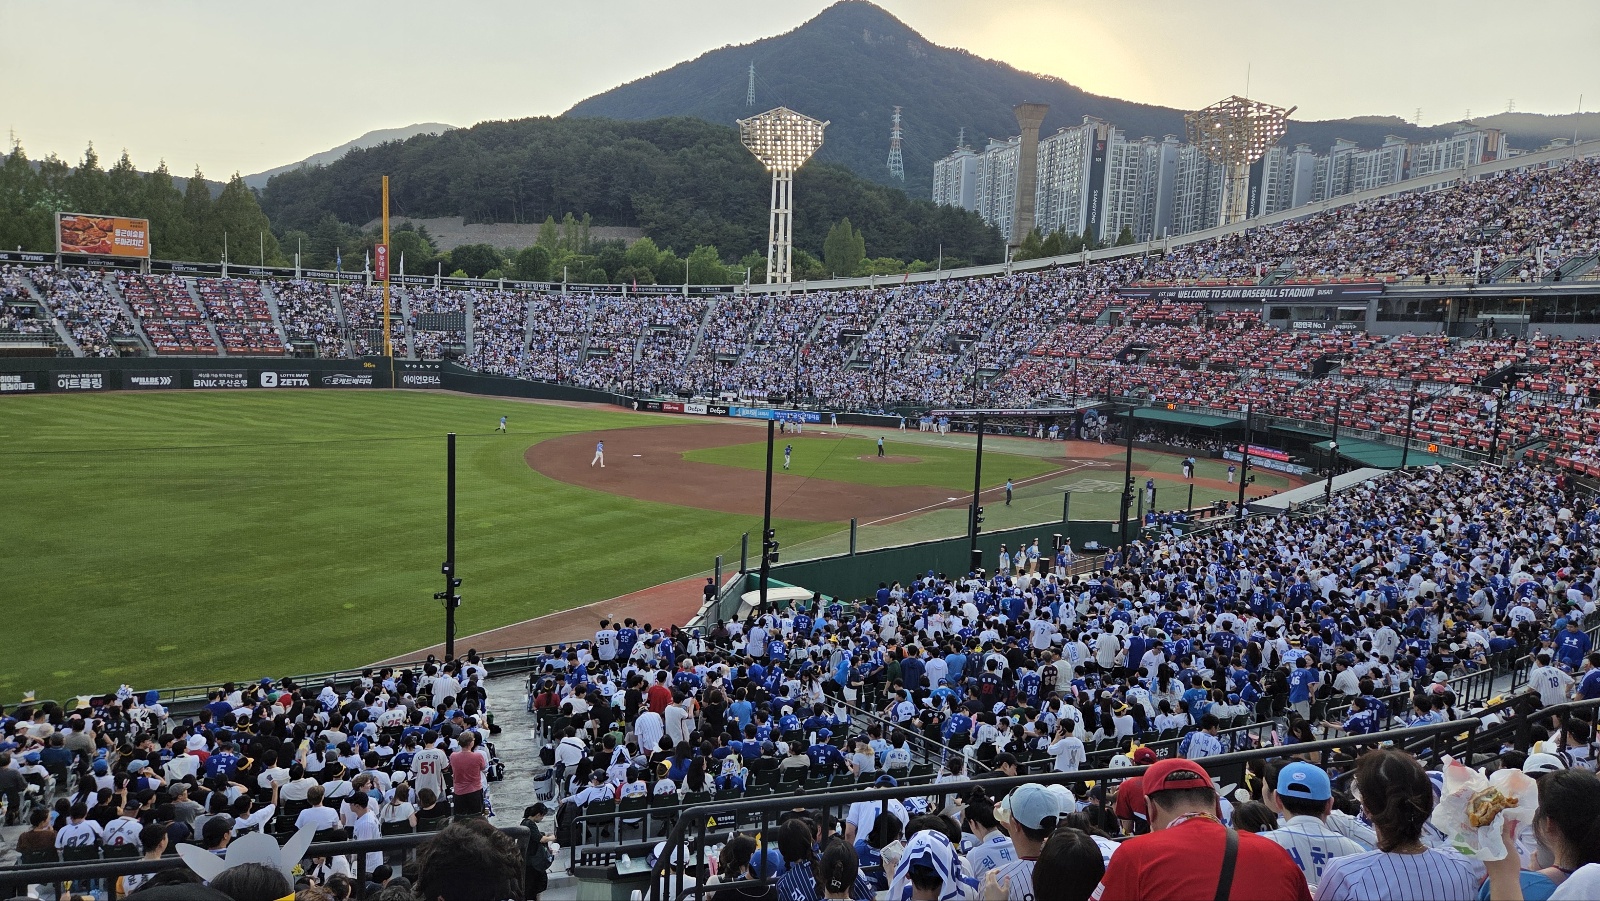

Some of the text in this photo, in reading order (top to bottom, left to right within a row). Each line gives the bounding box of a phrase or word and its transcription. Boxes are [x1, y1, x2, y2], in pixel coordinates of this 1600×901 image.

[1178, 290, 1210, 298] WELCOME
[1211, 290, 1220, 298] TO
[1221, 289, 1241, 298] SAJIK
[1242, 289, 1278, 298] BASEBALL
[1279, 288, 1316, 298] STADIUM
[57, 378, 103, 390] 아트몰링
[193, 379, 248, 387] BNK 부산은행
[266, 376, 273, 384] Z
[280, 378, 310, 386] ZETTA
[1222, 640, 1231, 649] 21
[1387, 636, 1393, 646] 5
[1549, 676, 1559, 688] 18
[1027, 685, 1038, 696] 58
[1155, 747, 1169, 758] 325
[217, 764, 227, 774] 5
[420, 761, 435, 775] 51
